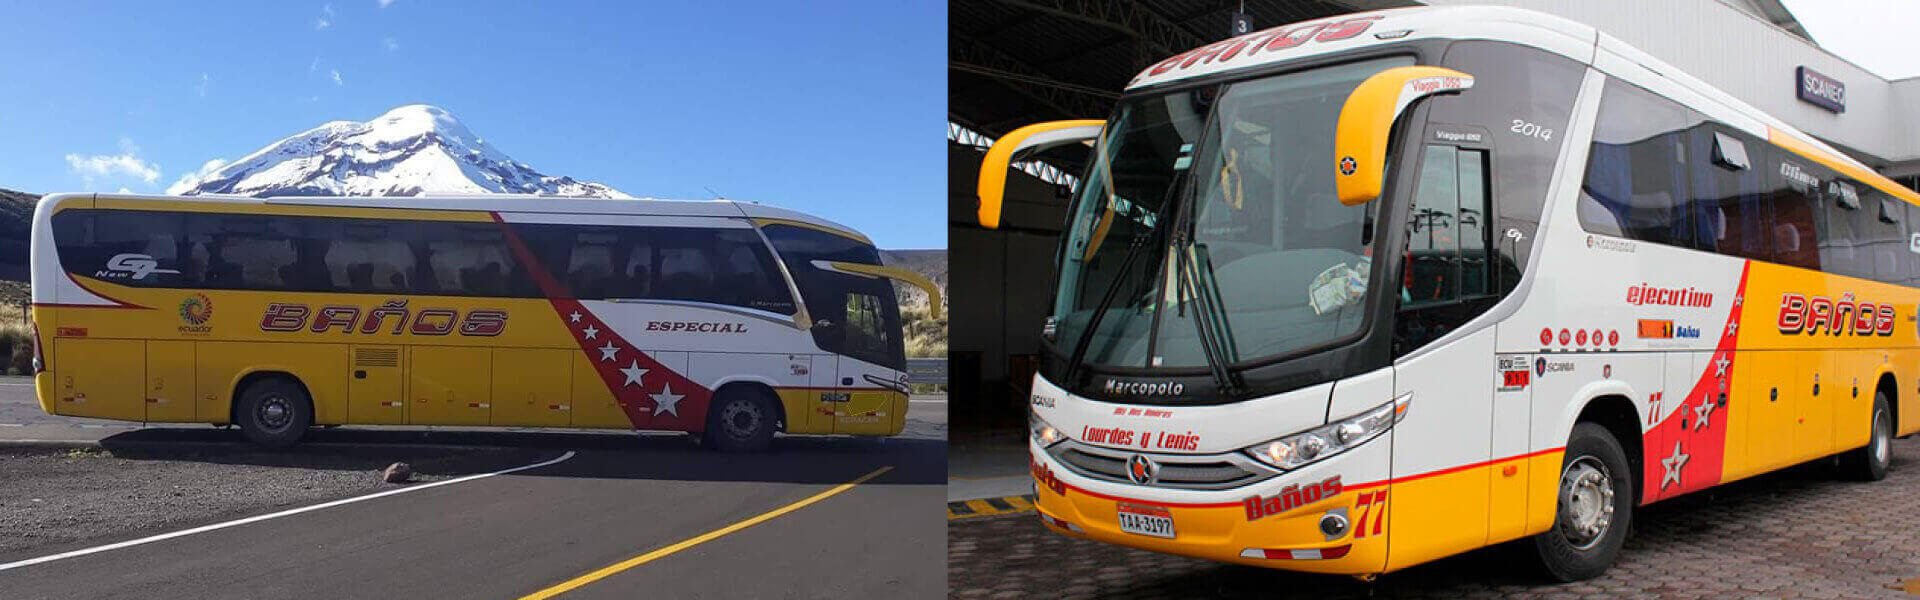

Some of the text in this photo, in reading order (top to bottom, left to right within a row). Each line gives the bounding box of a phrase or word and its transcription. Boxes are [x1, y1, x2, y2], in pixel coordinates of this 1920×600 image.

[1237, 19, 1248, 33] 3
[1511, 119, 1552, 141] 2014
[1626, 282, 1713, 308] ejecutivo
[260, 299, 508, 336] BAÑOS
[1777, 291, 1896, 336] BAÑOS
[177, 325, 213, 334] ecuador
[645, 321, 748, 334] ESPECIAL
[1105, 380, 1184, 396] Marcopolo
[1082, 424, 1201, 451] Lourdes y Lenis
[1244, 474, 1345, 521] Baños
[1120, 513, 1170, 534] TAA-3197
[1354, 489, 1389, 539] 77
